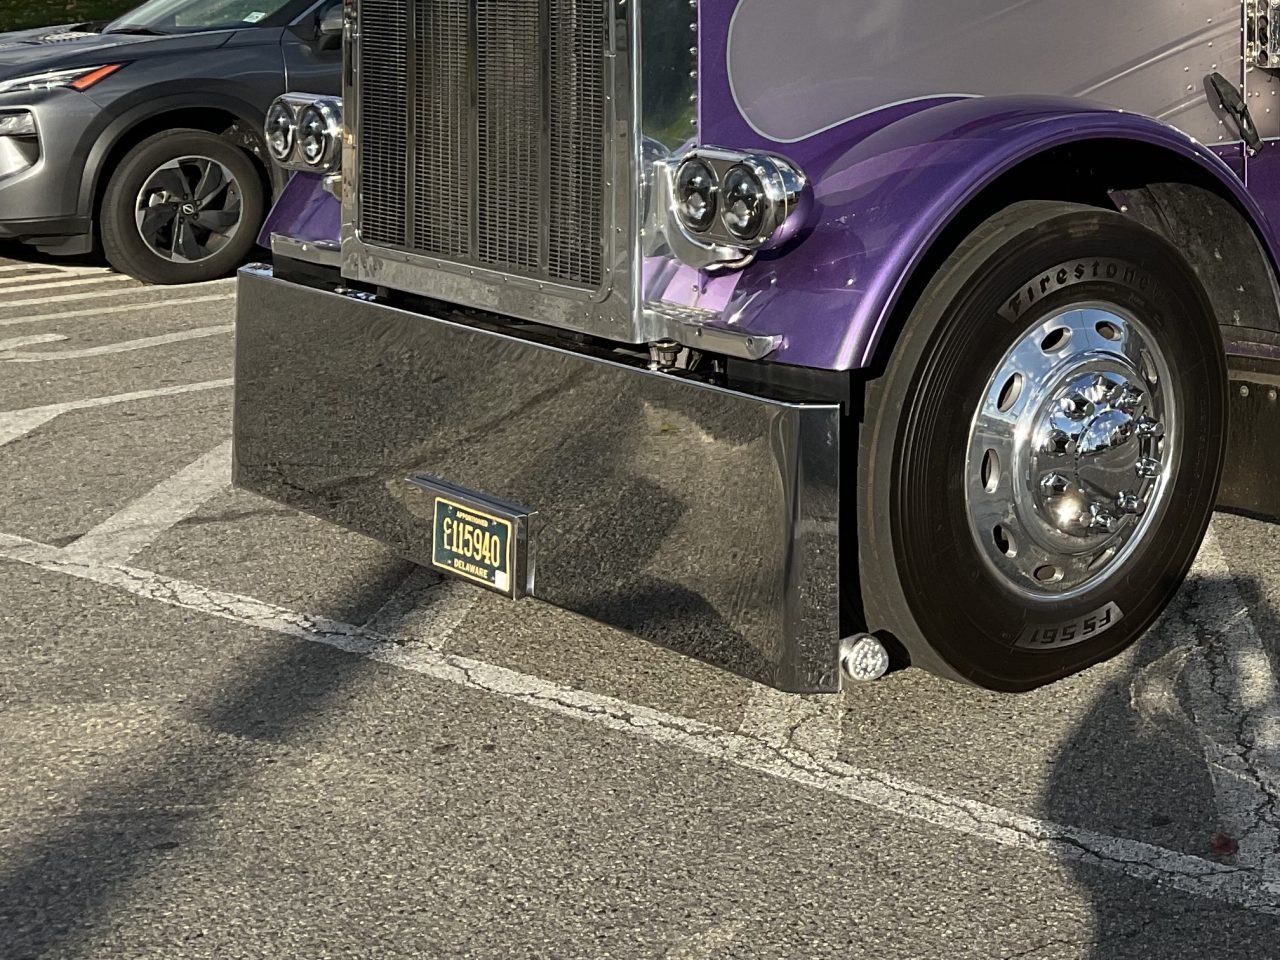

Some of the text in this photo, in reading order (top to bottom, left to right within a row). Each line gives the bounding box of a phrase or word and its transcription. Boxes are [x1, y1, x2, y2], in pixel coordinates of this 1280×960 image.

[1008, 259, 1149, 317] Firestone
[453, 558, 489, 579] DELAWARE
[1030, 607, 1113, 644] FS561
